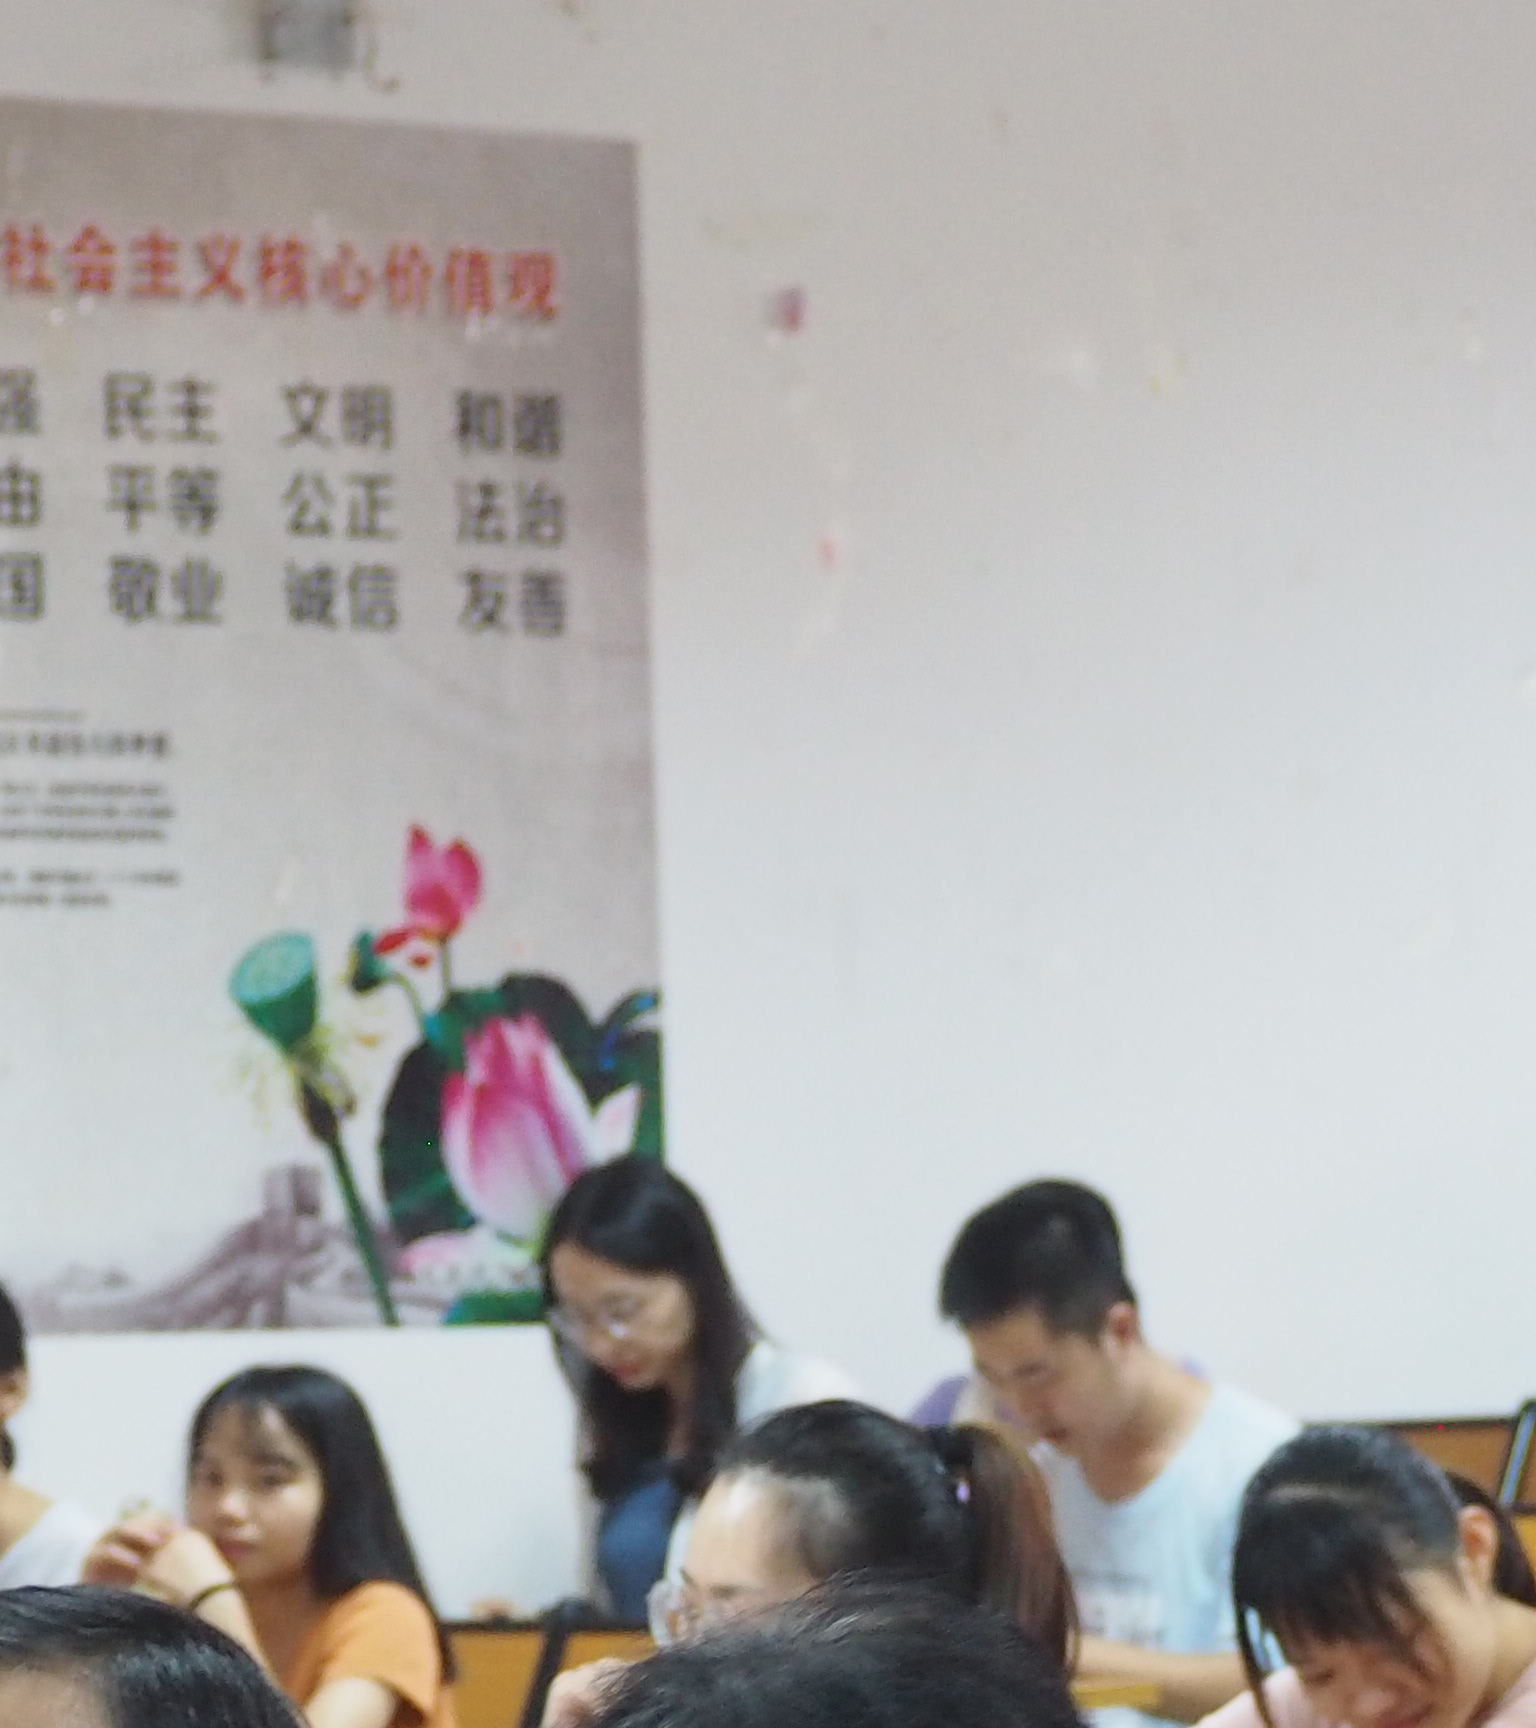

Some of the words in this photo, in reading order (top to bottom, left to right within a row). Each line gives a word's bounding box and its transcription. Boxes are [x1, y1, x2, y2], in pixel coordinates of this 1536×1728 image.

[104, 370, 220, 445] 民主
[280, 380, 395, 450] 文明
[106, 463, 222, 536] 平等
[281, 470, 399, 543] 公正
[455, 481, 565, 550] 法治
[108, 554, 225, 628] 敬业
[283, 561, 400, 634] 诚信
[458, 567, 566, 638] 友善
